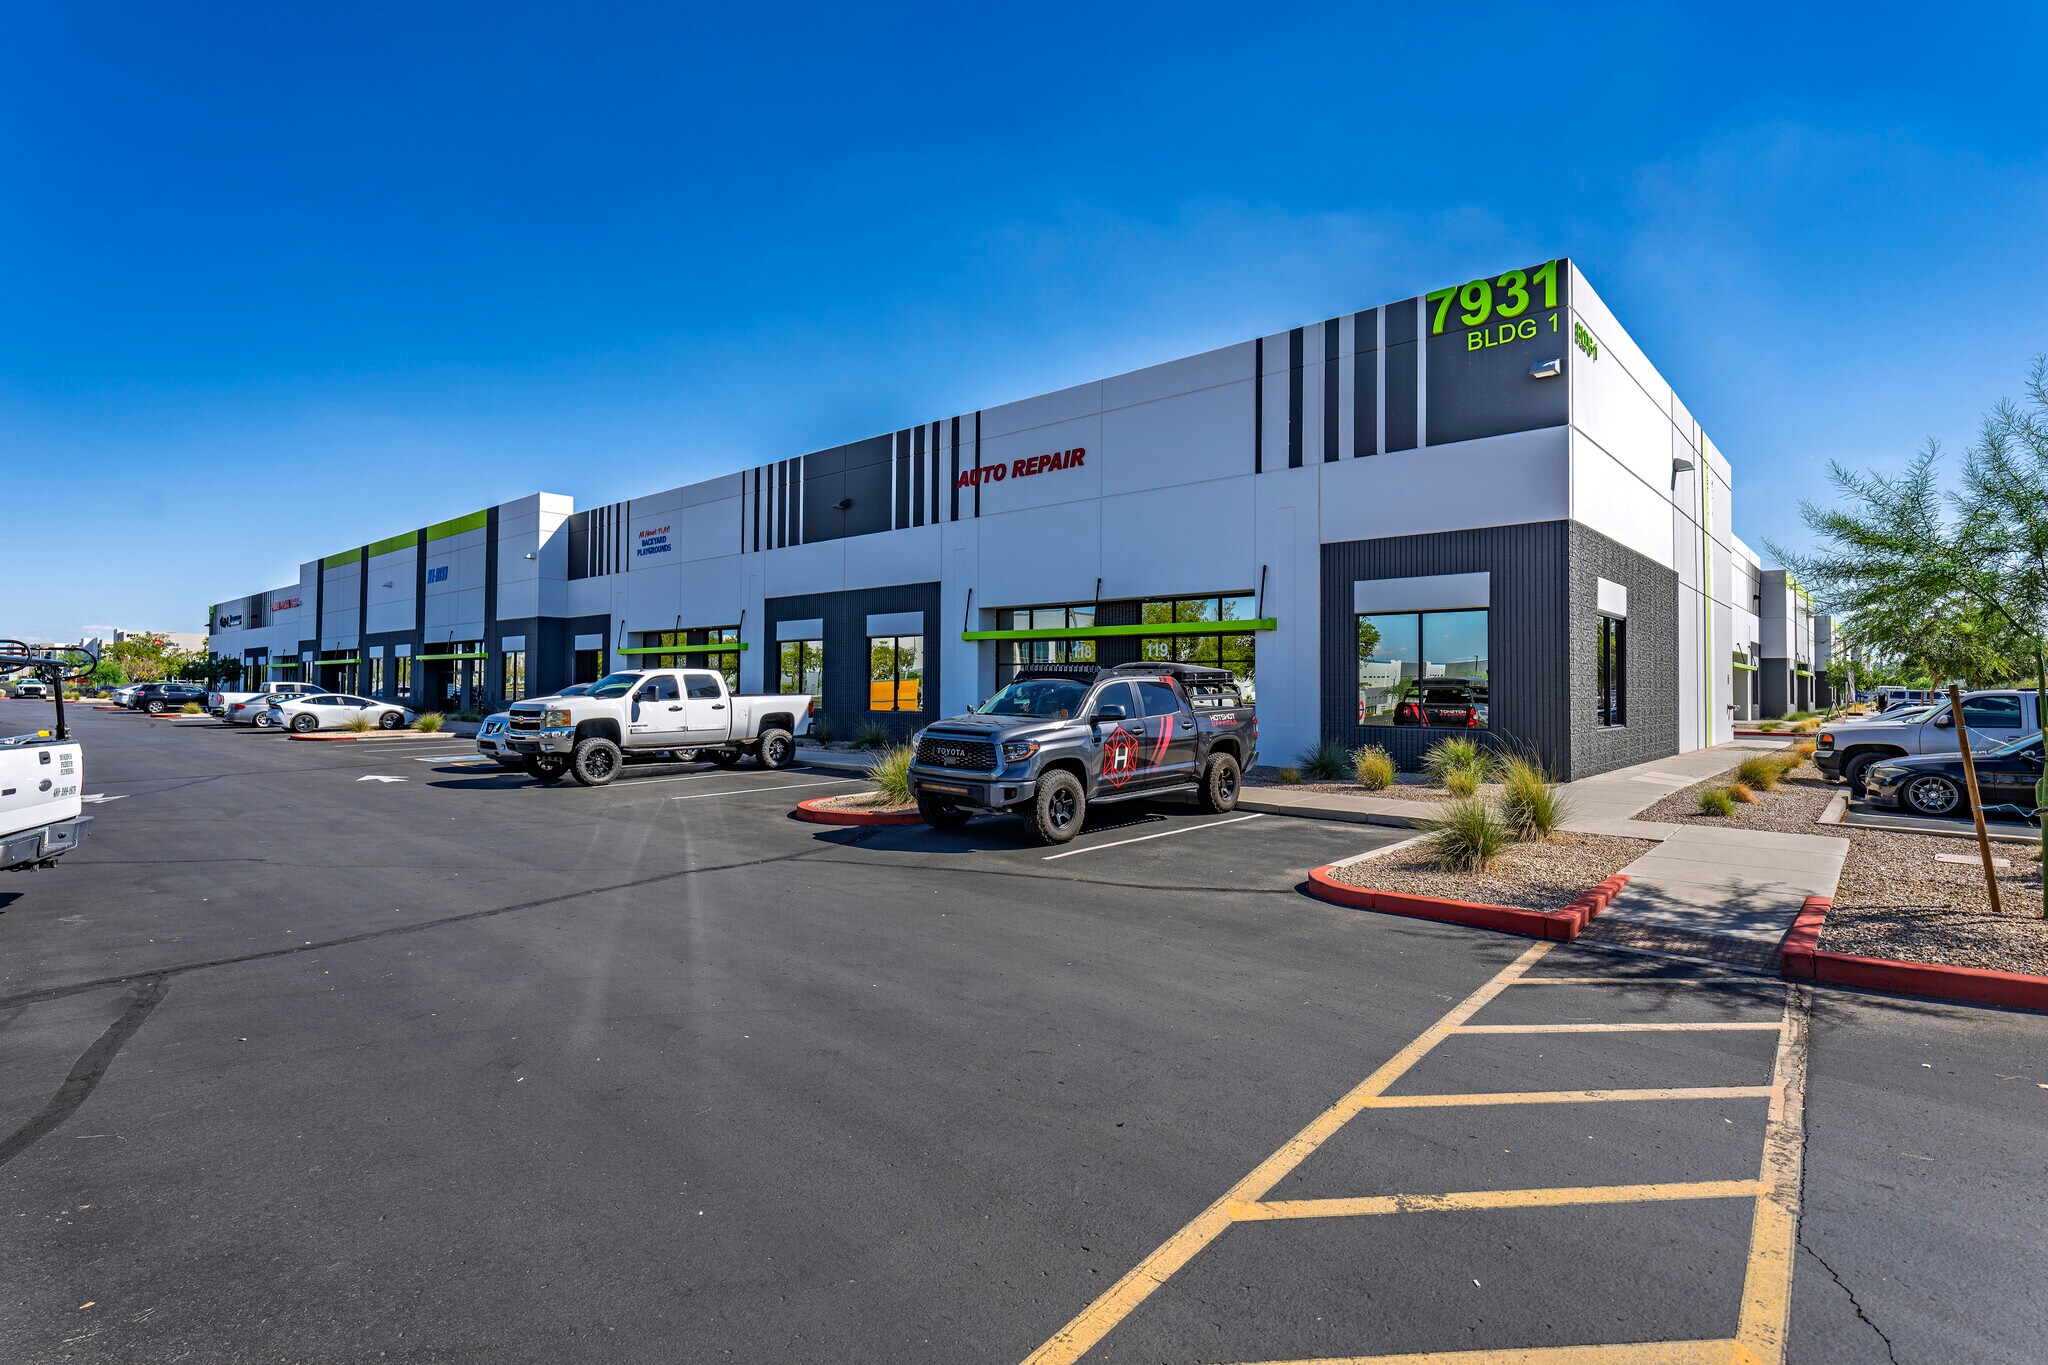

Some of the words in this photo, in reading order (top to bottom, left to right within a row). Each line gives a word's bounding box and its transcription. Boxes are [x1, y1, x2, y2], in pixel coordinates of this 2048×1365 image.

[1426, 259, 1558, 335] 7931
[1467, 318, 1537, 352] BLDG
[1548, 312, 1558, 333] 1
[957, 463, 1007, 489] AUTO
[1011, 447, 1086, 479] REPAIR
[641, 535, 667, 547] BACKYARD
[637, 543, 672, 557] PLAYGROUNDS
[1072, 644, 1093, 659] 118
[1146, 642, 1169, 658] 119
[1209, 713, 1235, 721] HOTSHOT
[936, 747, 966, 757] TOYOTA
[1114, 746, 1129, 770] H
